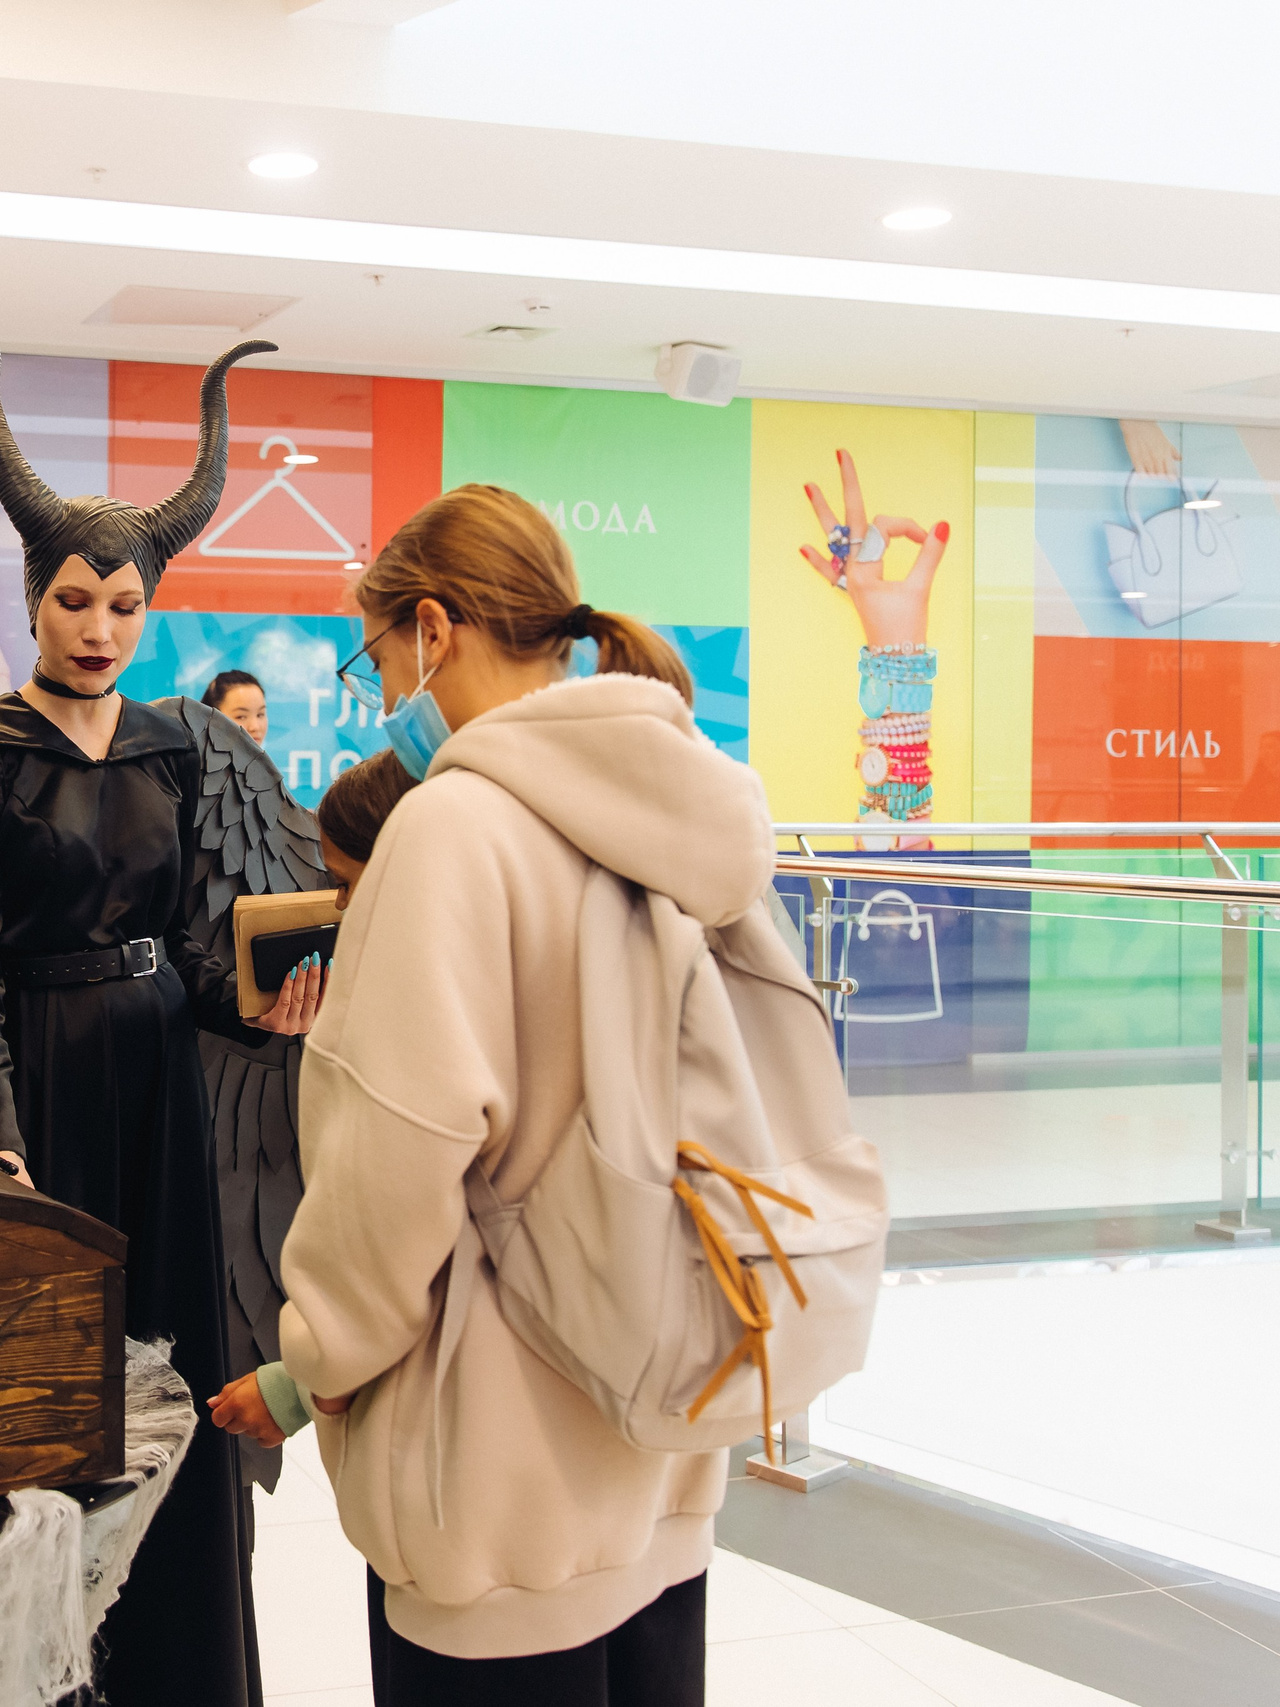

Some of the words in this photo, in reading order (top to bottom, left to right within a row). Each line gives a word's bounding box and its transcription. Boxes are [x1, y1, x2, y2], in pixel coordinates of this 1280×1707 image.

[538, 500, 657, 536] МОДА
[309, 688, 387, 729] ГЛ
[1105, 728, 1221, 759] СТИЛЬ
